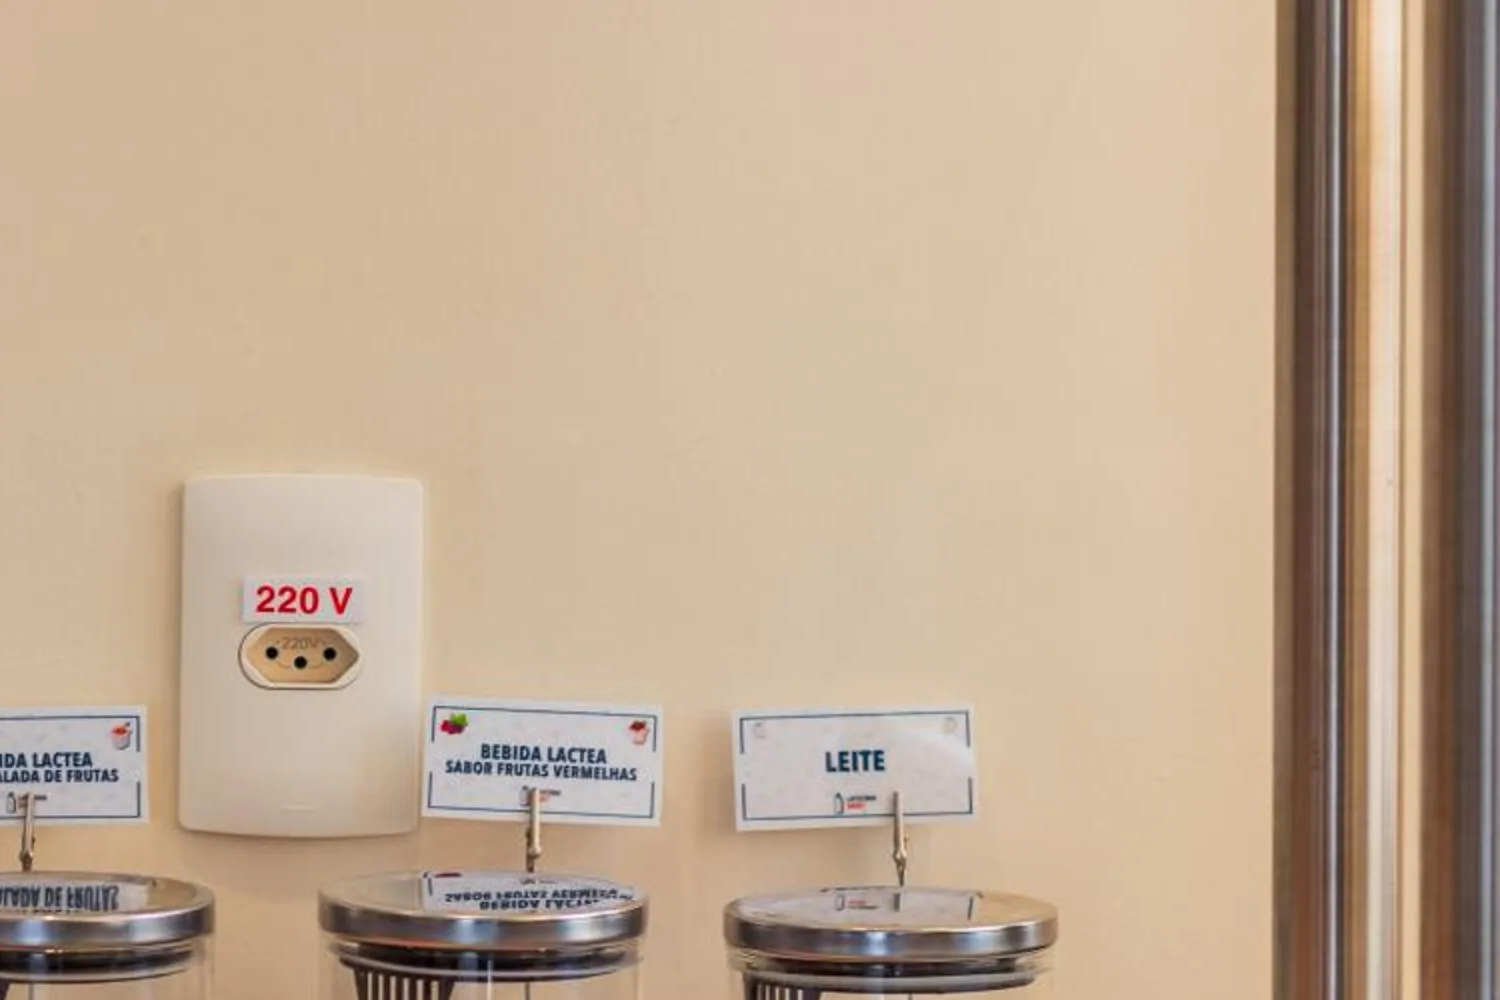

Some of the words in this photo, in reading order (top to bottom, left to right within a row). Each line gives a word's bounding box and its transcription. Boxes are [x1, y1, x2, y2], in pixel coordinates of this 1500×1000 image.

[256, 585, 320, 615] 220
[329, 587, 353, 615] V
[32, 751, 93, 769] LACTEA
[480, 743, 542, 762] BEBIDA
[547, 747, 607, 765] LACTEA
[825, 749, 886, 773] LEITE
[43, 769, 62, 783] DE
[65, 768, 119, 783] FRUTAS
[445, 760, 493, 776] SABOR
[496, 761, 549, 778] FRUTAS
[553, 764, 637, 782] VERMELHAS
